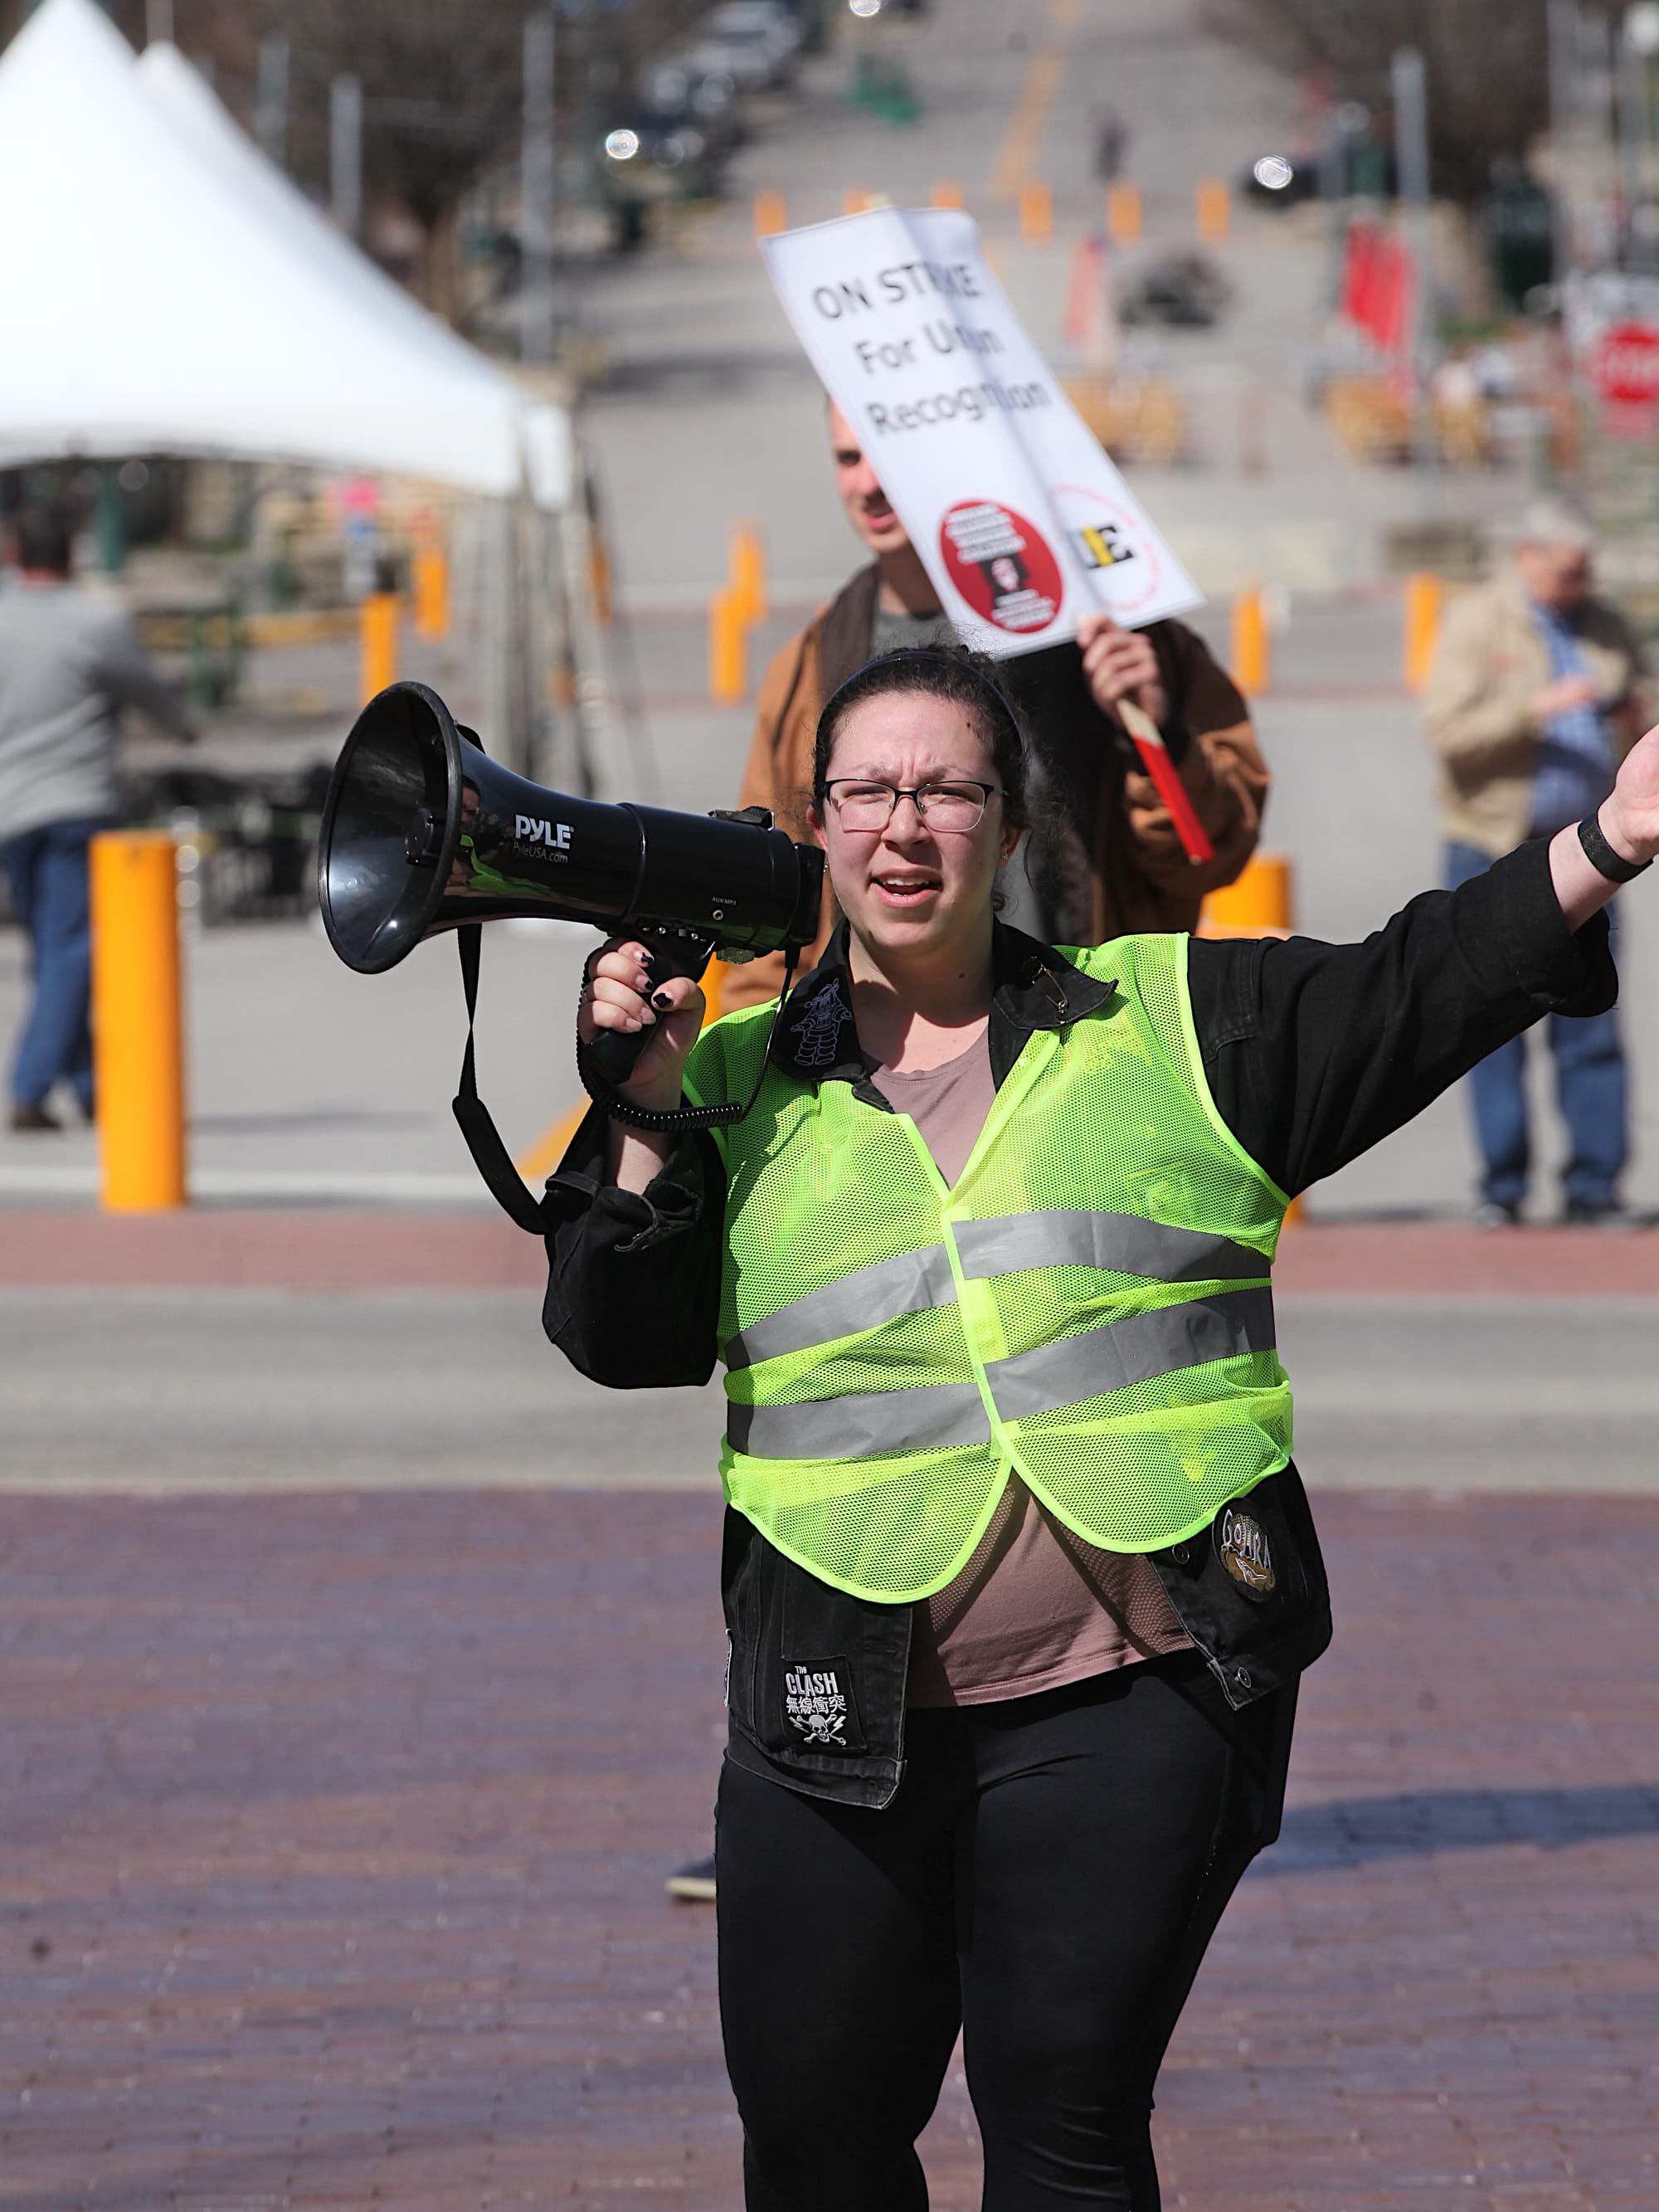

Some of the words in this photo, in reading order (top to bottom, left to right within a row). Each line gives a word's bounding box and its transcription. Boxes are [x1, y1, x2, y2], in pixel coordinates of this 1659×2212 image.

[813, 276, 871, 319] ON
[854, 339, 915, 373] For
[515, 814, 572, 850] PYLE
[786, 1672, 839, 1696] CLASH
